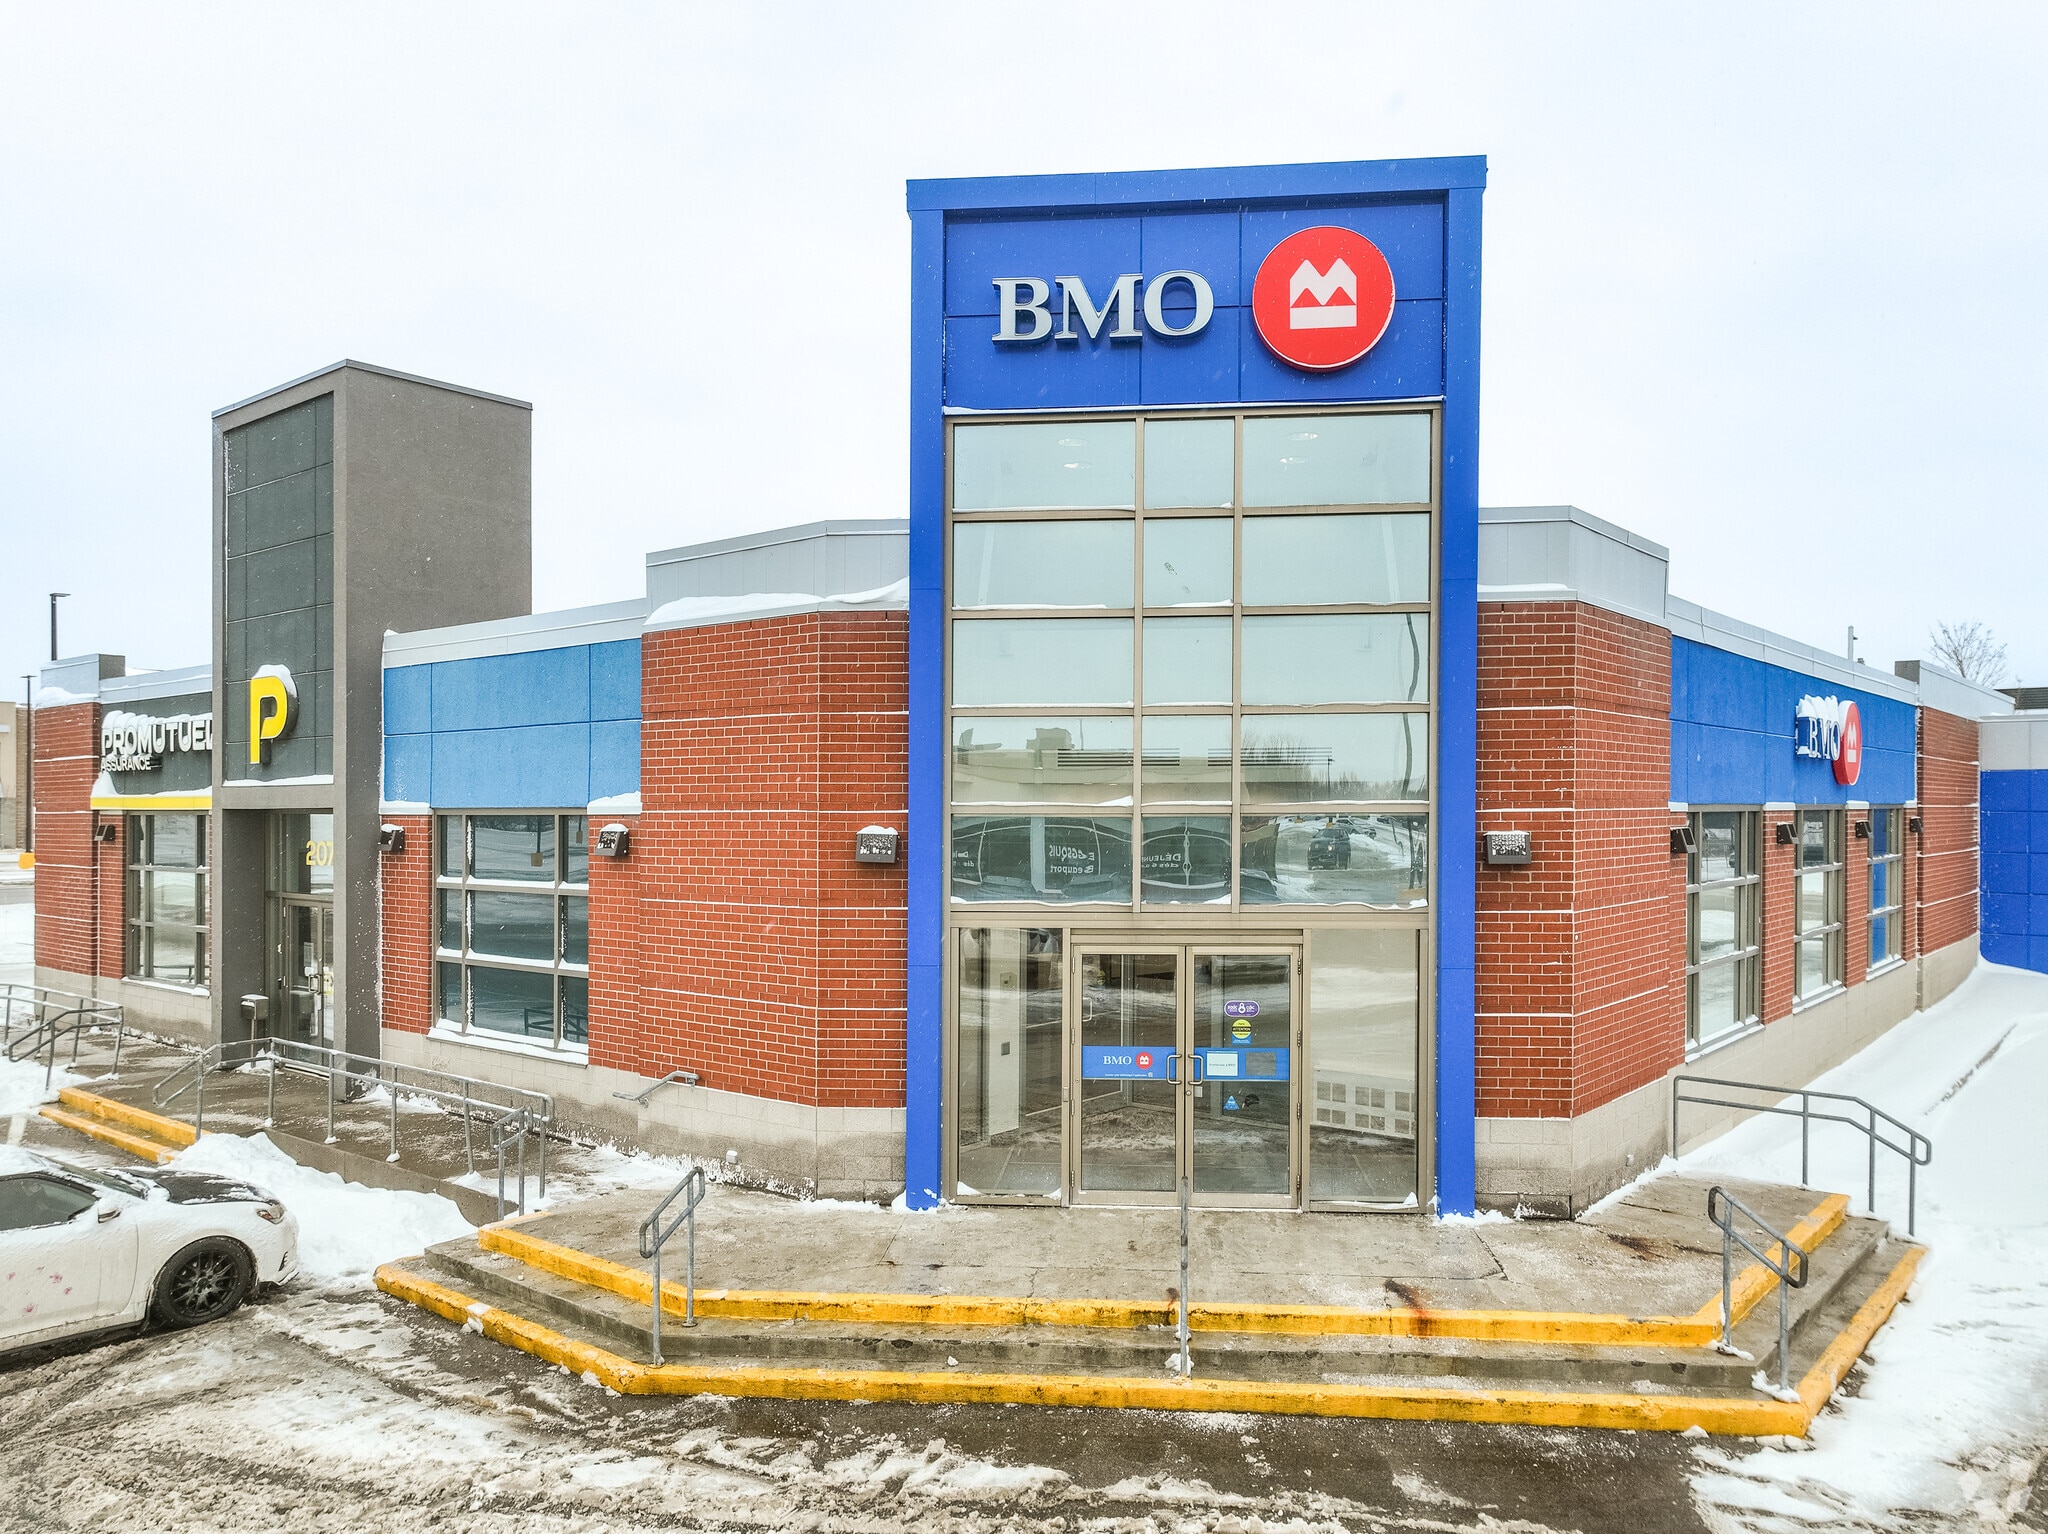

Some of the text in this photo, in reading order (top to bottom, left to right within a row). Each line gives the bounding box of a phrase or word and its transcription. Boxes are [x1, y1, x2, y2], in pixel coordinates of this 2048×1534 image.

[992, 270, 1214, 343] BMO
[250, 676, 288, 765] P
[1809, 717, 1840, 760] BMO
[101, 756, 151, 772] ASSURANCE
[1103, 1055, 1132, 1065] BMO
